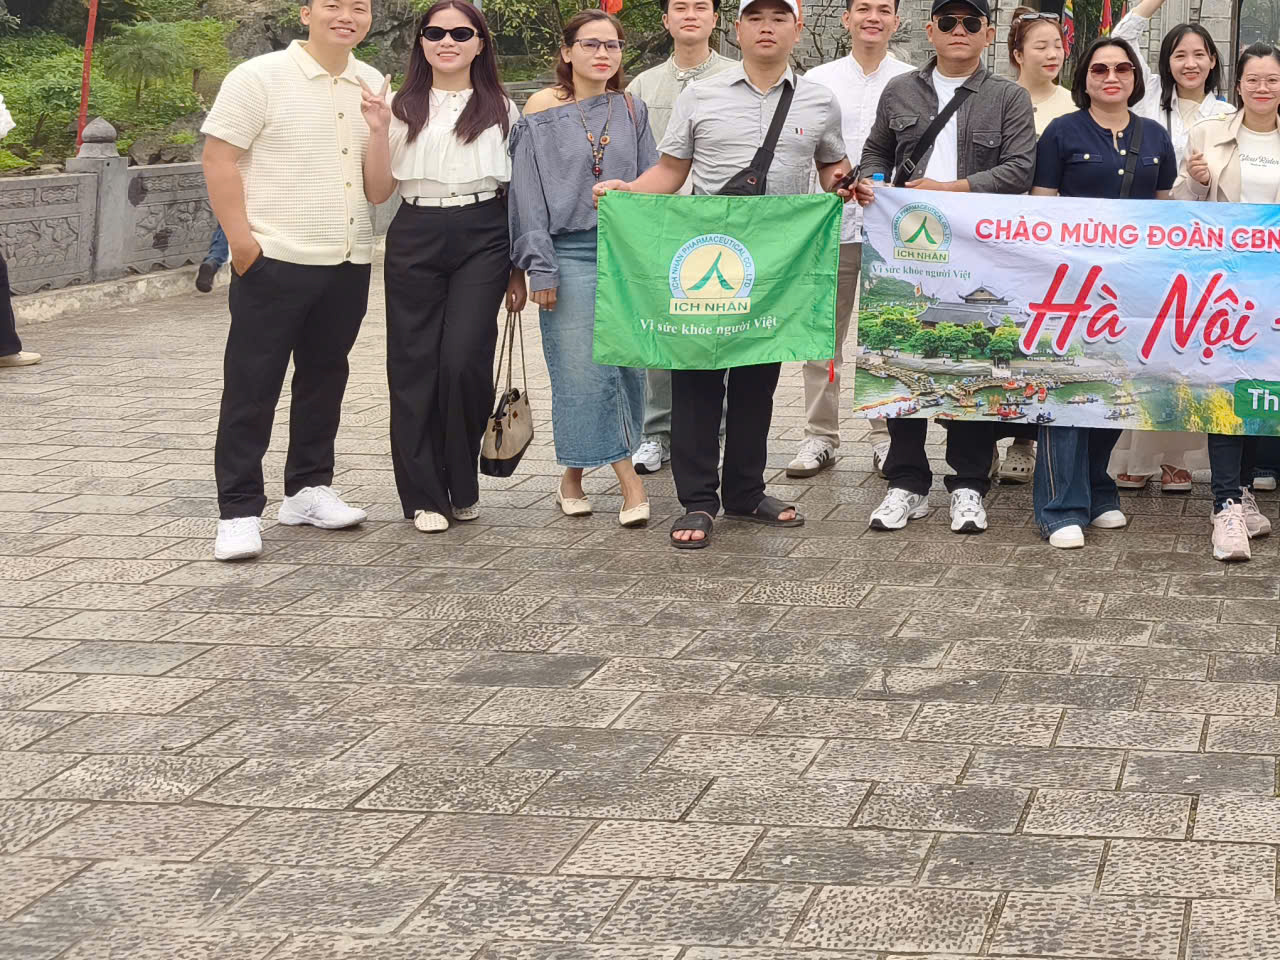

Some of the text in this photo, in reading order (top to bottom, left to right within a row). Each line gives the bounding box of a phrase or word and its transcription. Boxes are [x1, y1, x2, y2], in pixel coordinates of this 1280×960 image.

[975, 216, 1053, 241] CHÀO
[1060, 218, 1139, 245] MỪNG
[1147, 221, 1224, 248] ĐOÀN
[682, 236, 746, 256] PHARMACEUTICAL
[1022, 263, 1127, 351] Hà
[1140, 272, 1258, 360] Nội
[657, 322, 677, 333] sức
[716, 320, 750, 336] người
[753, 316, 777, 329] Việt
